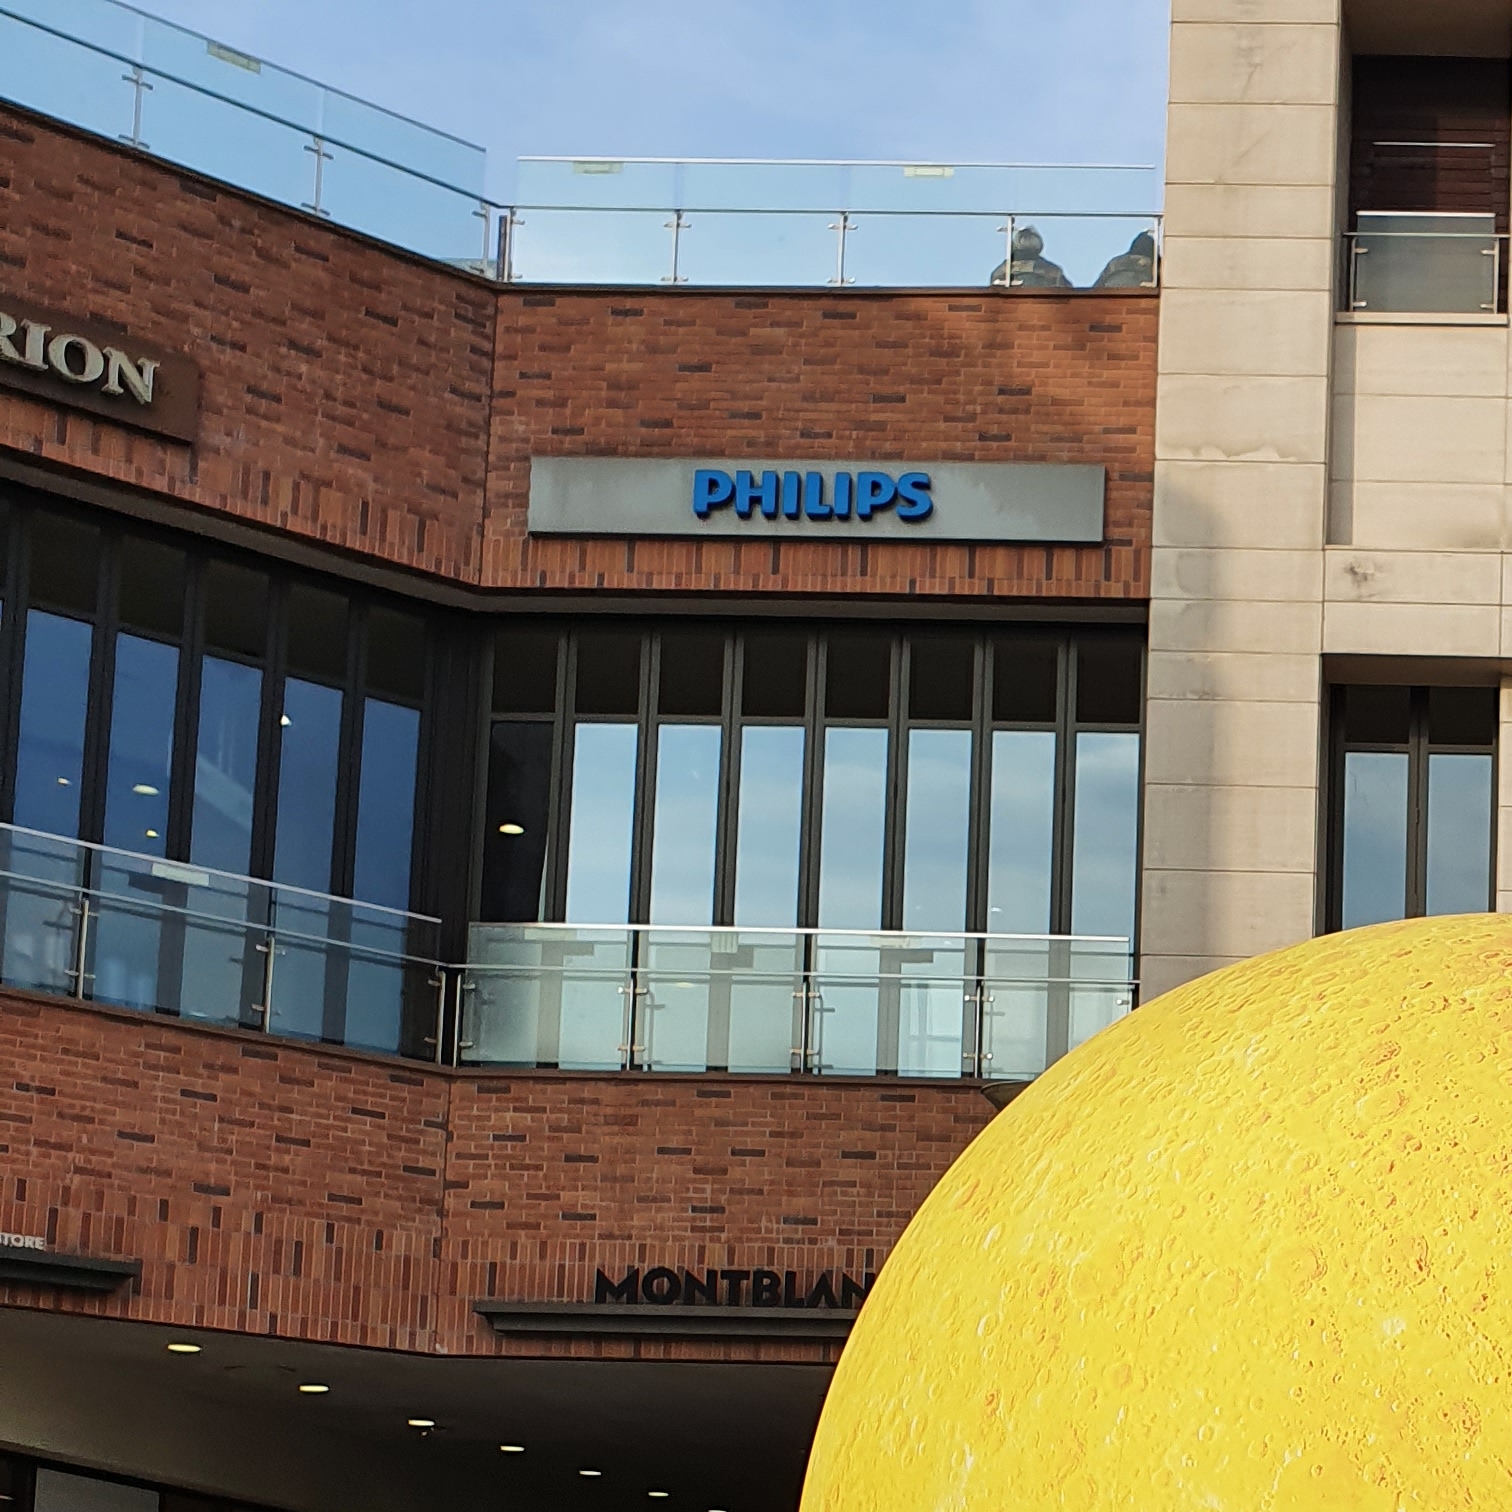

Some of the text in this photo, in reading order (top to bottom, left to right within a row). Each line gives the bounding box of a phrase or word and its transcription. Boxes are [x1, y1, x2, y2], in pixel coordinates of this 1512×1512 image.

[694, 469, 934, 521] PHILIPS
[0, 1231, 46, 1252] TORE
[594, 1266, 877, 1309] MONTBLAN
